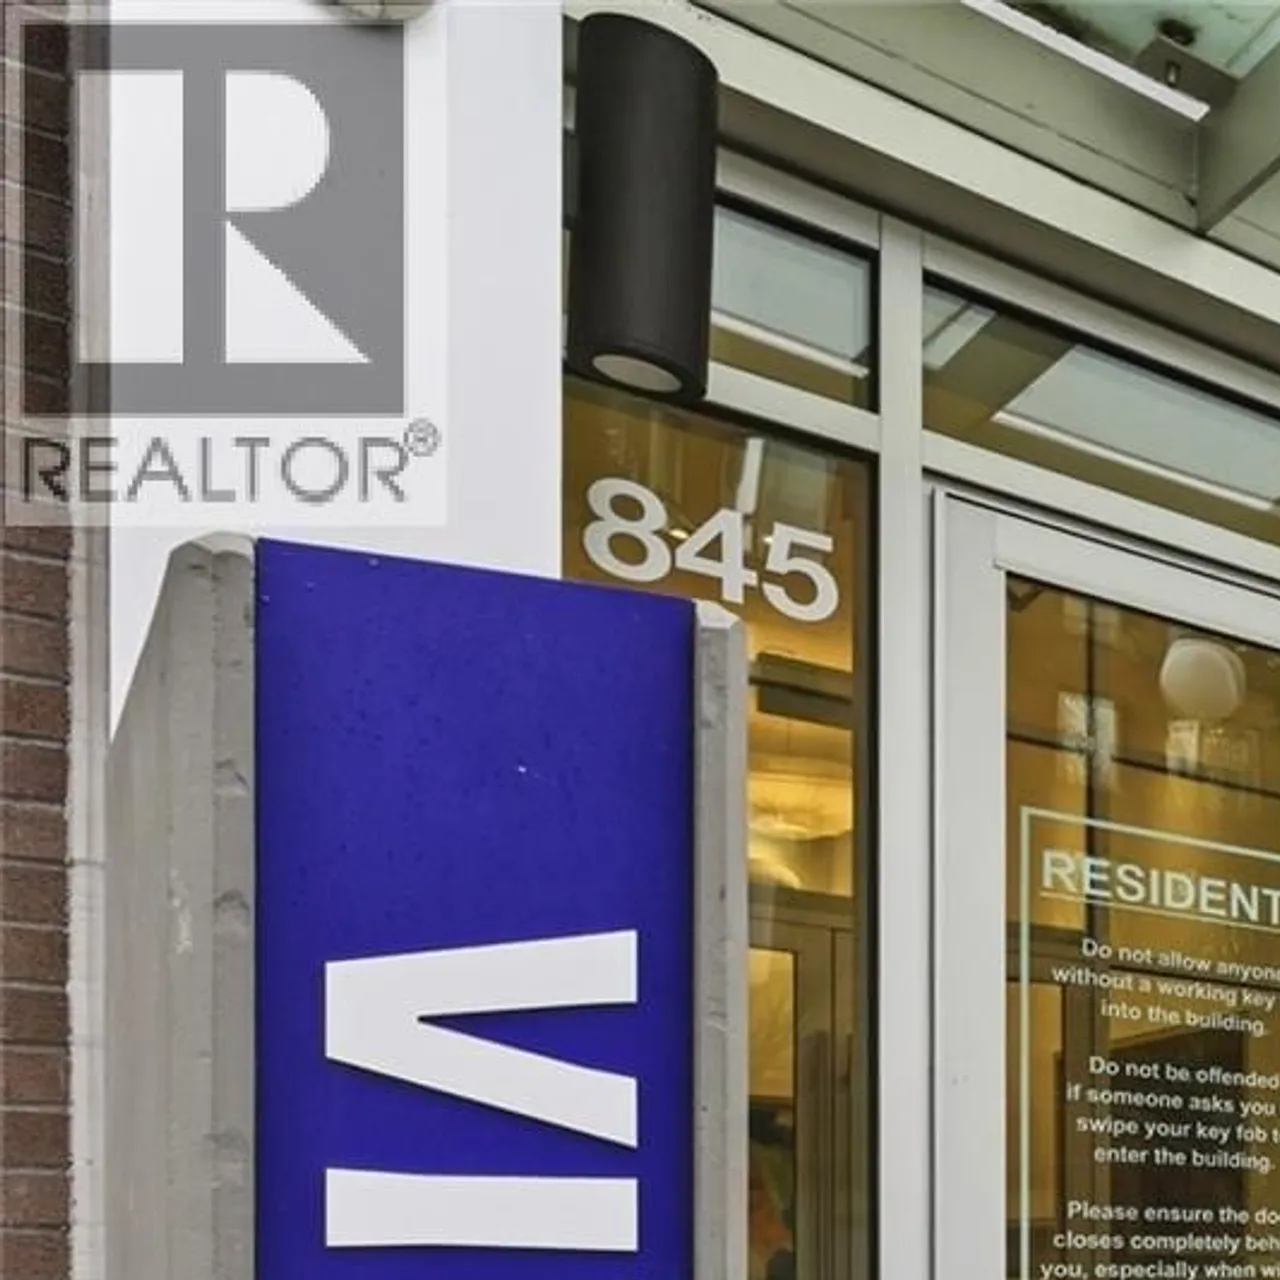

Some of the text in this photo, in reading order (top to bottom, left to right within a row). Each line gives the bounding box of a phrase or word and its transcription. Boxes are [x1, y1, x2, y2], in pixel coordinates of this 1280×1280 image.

[583, 477, 839, 622] 845
[1082, 938, 1111, 958] Do
[1118, 945, 1152, 964] not
[1158, 951, 1211, 971] allow
[1052, 966, 1133, 989] without
[1140, 980, 1151, 992] a
[1157, 981, 1236, 1006] working
[1242, 989, 1275, 1011] key
[1102, 1001, 1269, 1036] into the building.
[1089, 1056, 1280, 1089] Do not be offended
[1066, 1083, 1081, 1101] if
[1087, 1090, 1183, 1107] someone
[1189, 1095, 1233, 1112] asks
[1240, 1101, 1275, 1118] you
[1077, 1116, 1137, 1134] swipe
[1145, 1121, 1191, 1139] your
[1196, 1124, 1230, 1144] key
[1236, 1125, 1267, 1141] fob
[1094, 1146, 1276, 1173] enter the building.
[1067, 1200, 1138, 1220] Please
[1144, 1207, 1213, 1222] ensure
[1219, 1207, 1248, 1223] the
[1053, 1232, 1124, 1249] closes
[1130, 1233, 1240, 1254] completely
[1204, 1261, 1255, 1278] when
